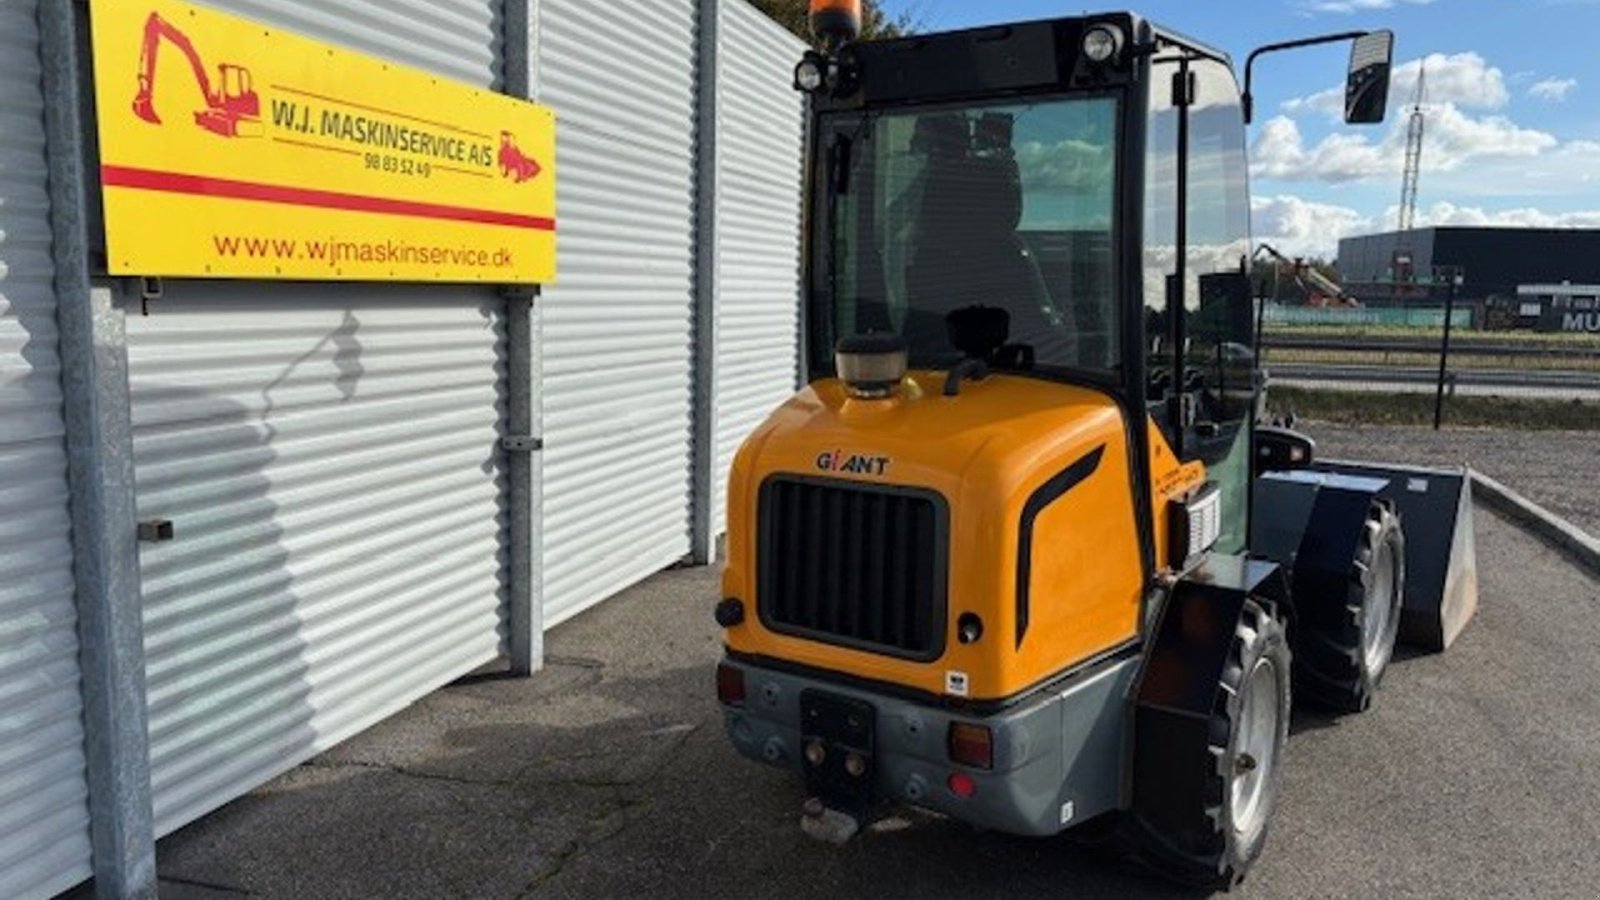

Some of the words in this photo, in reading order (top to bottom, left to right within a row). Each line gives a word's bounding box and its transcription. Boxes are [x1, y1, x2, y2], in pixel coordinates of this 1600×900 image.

[272, 99, 315, 134] W.J.
[320, 110, 465, 161] MASKINSERVICE
[468, 144, 493, 167] A/S
[365, 152, 380, 170] 98
[383, 155, 398, 173] 83
[400, 158, 414, 176] 52
[213, 235, 513, 268] www.wjmaskinservice.dk
